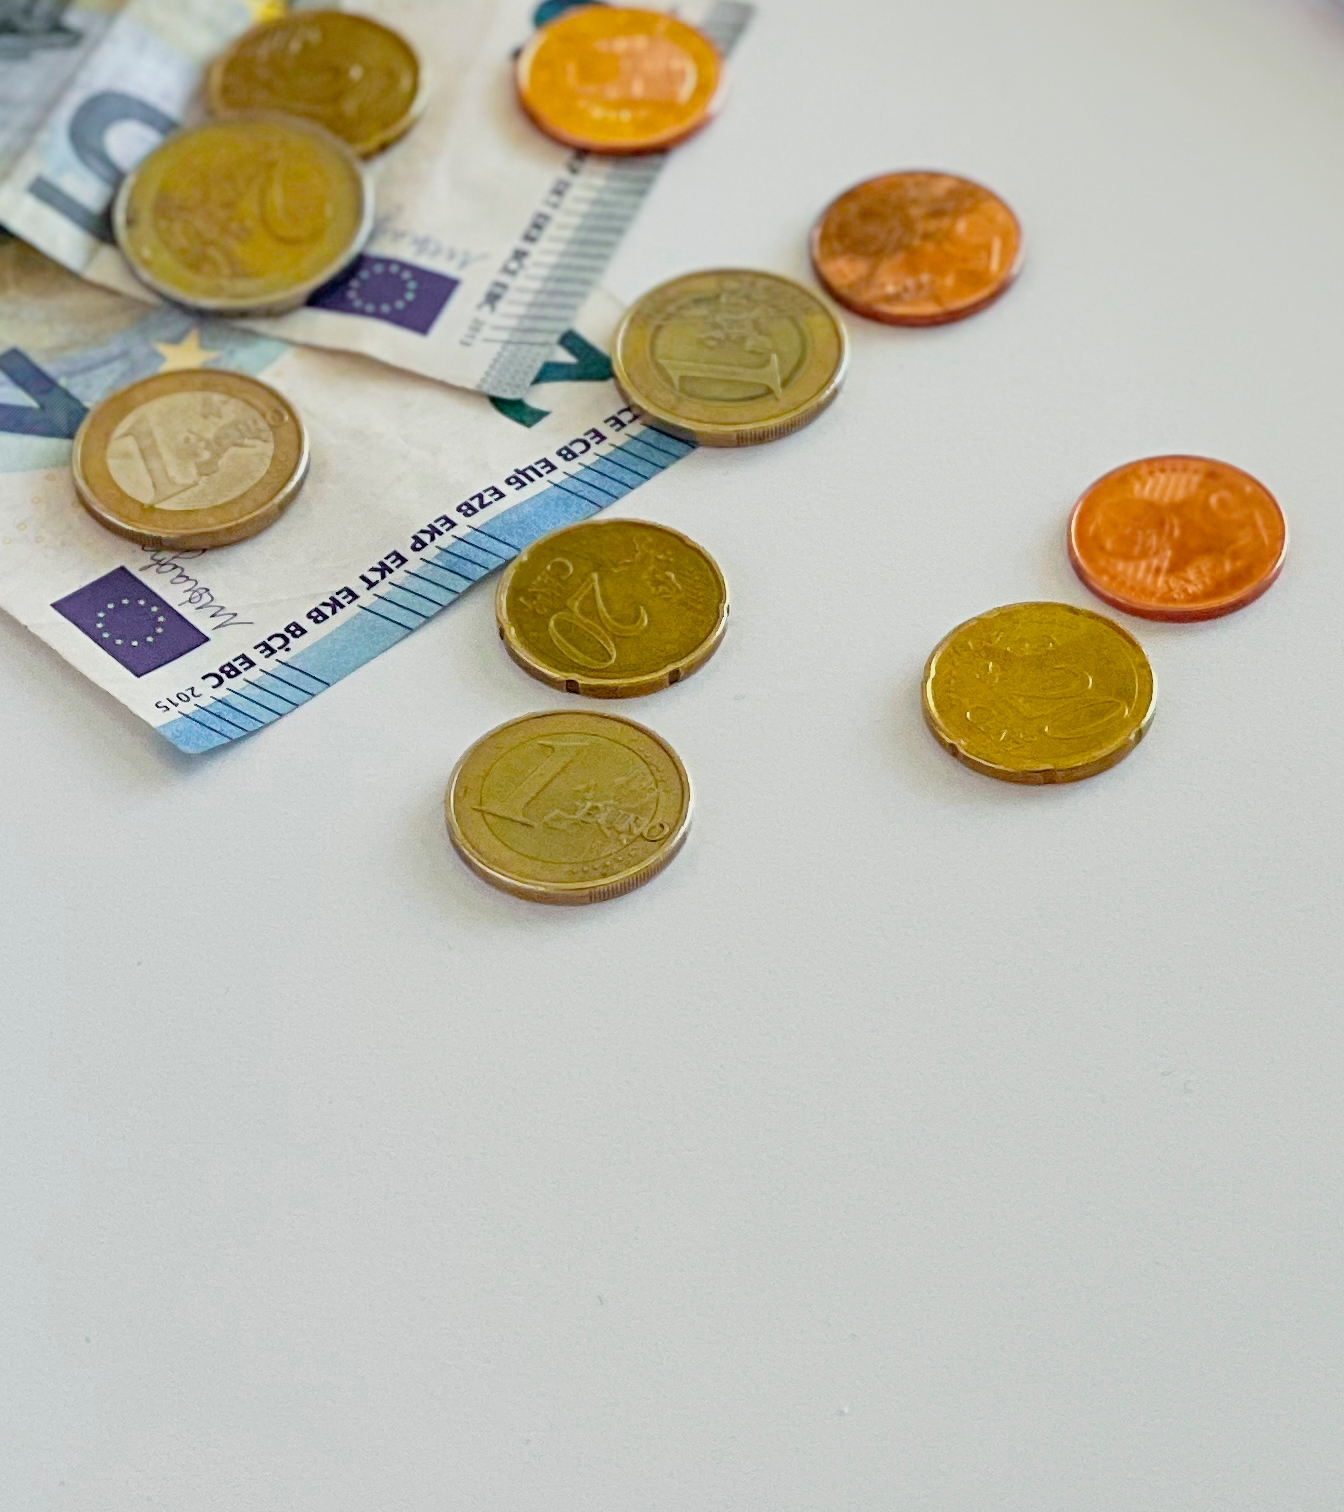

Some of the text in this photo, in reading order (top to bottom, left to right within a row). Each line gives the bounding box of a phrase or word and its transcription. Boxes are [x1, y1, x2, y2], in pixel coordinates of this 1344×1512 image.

[603, 406, 642, 433] CE
[556, 427, 608, 462] ECB
[504, 457, 559, 491] ЕЦБ
[455, 485, 507, 518] EZB
[410, 514, 458, 552] EKP
[358, 549, 409, 591] EKT
[306, 586, 361, 625] EKB
[549, 572, 648, 669] 20
[201, 653, 256, 689] EBC
[154, 686, 203, 713] 2015
[471, 740, 590, 828] 1
